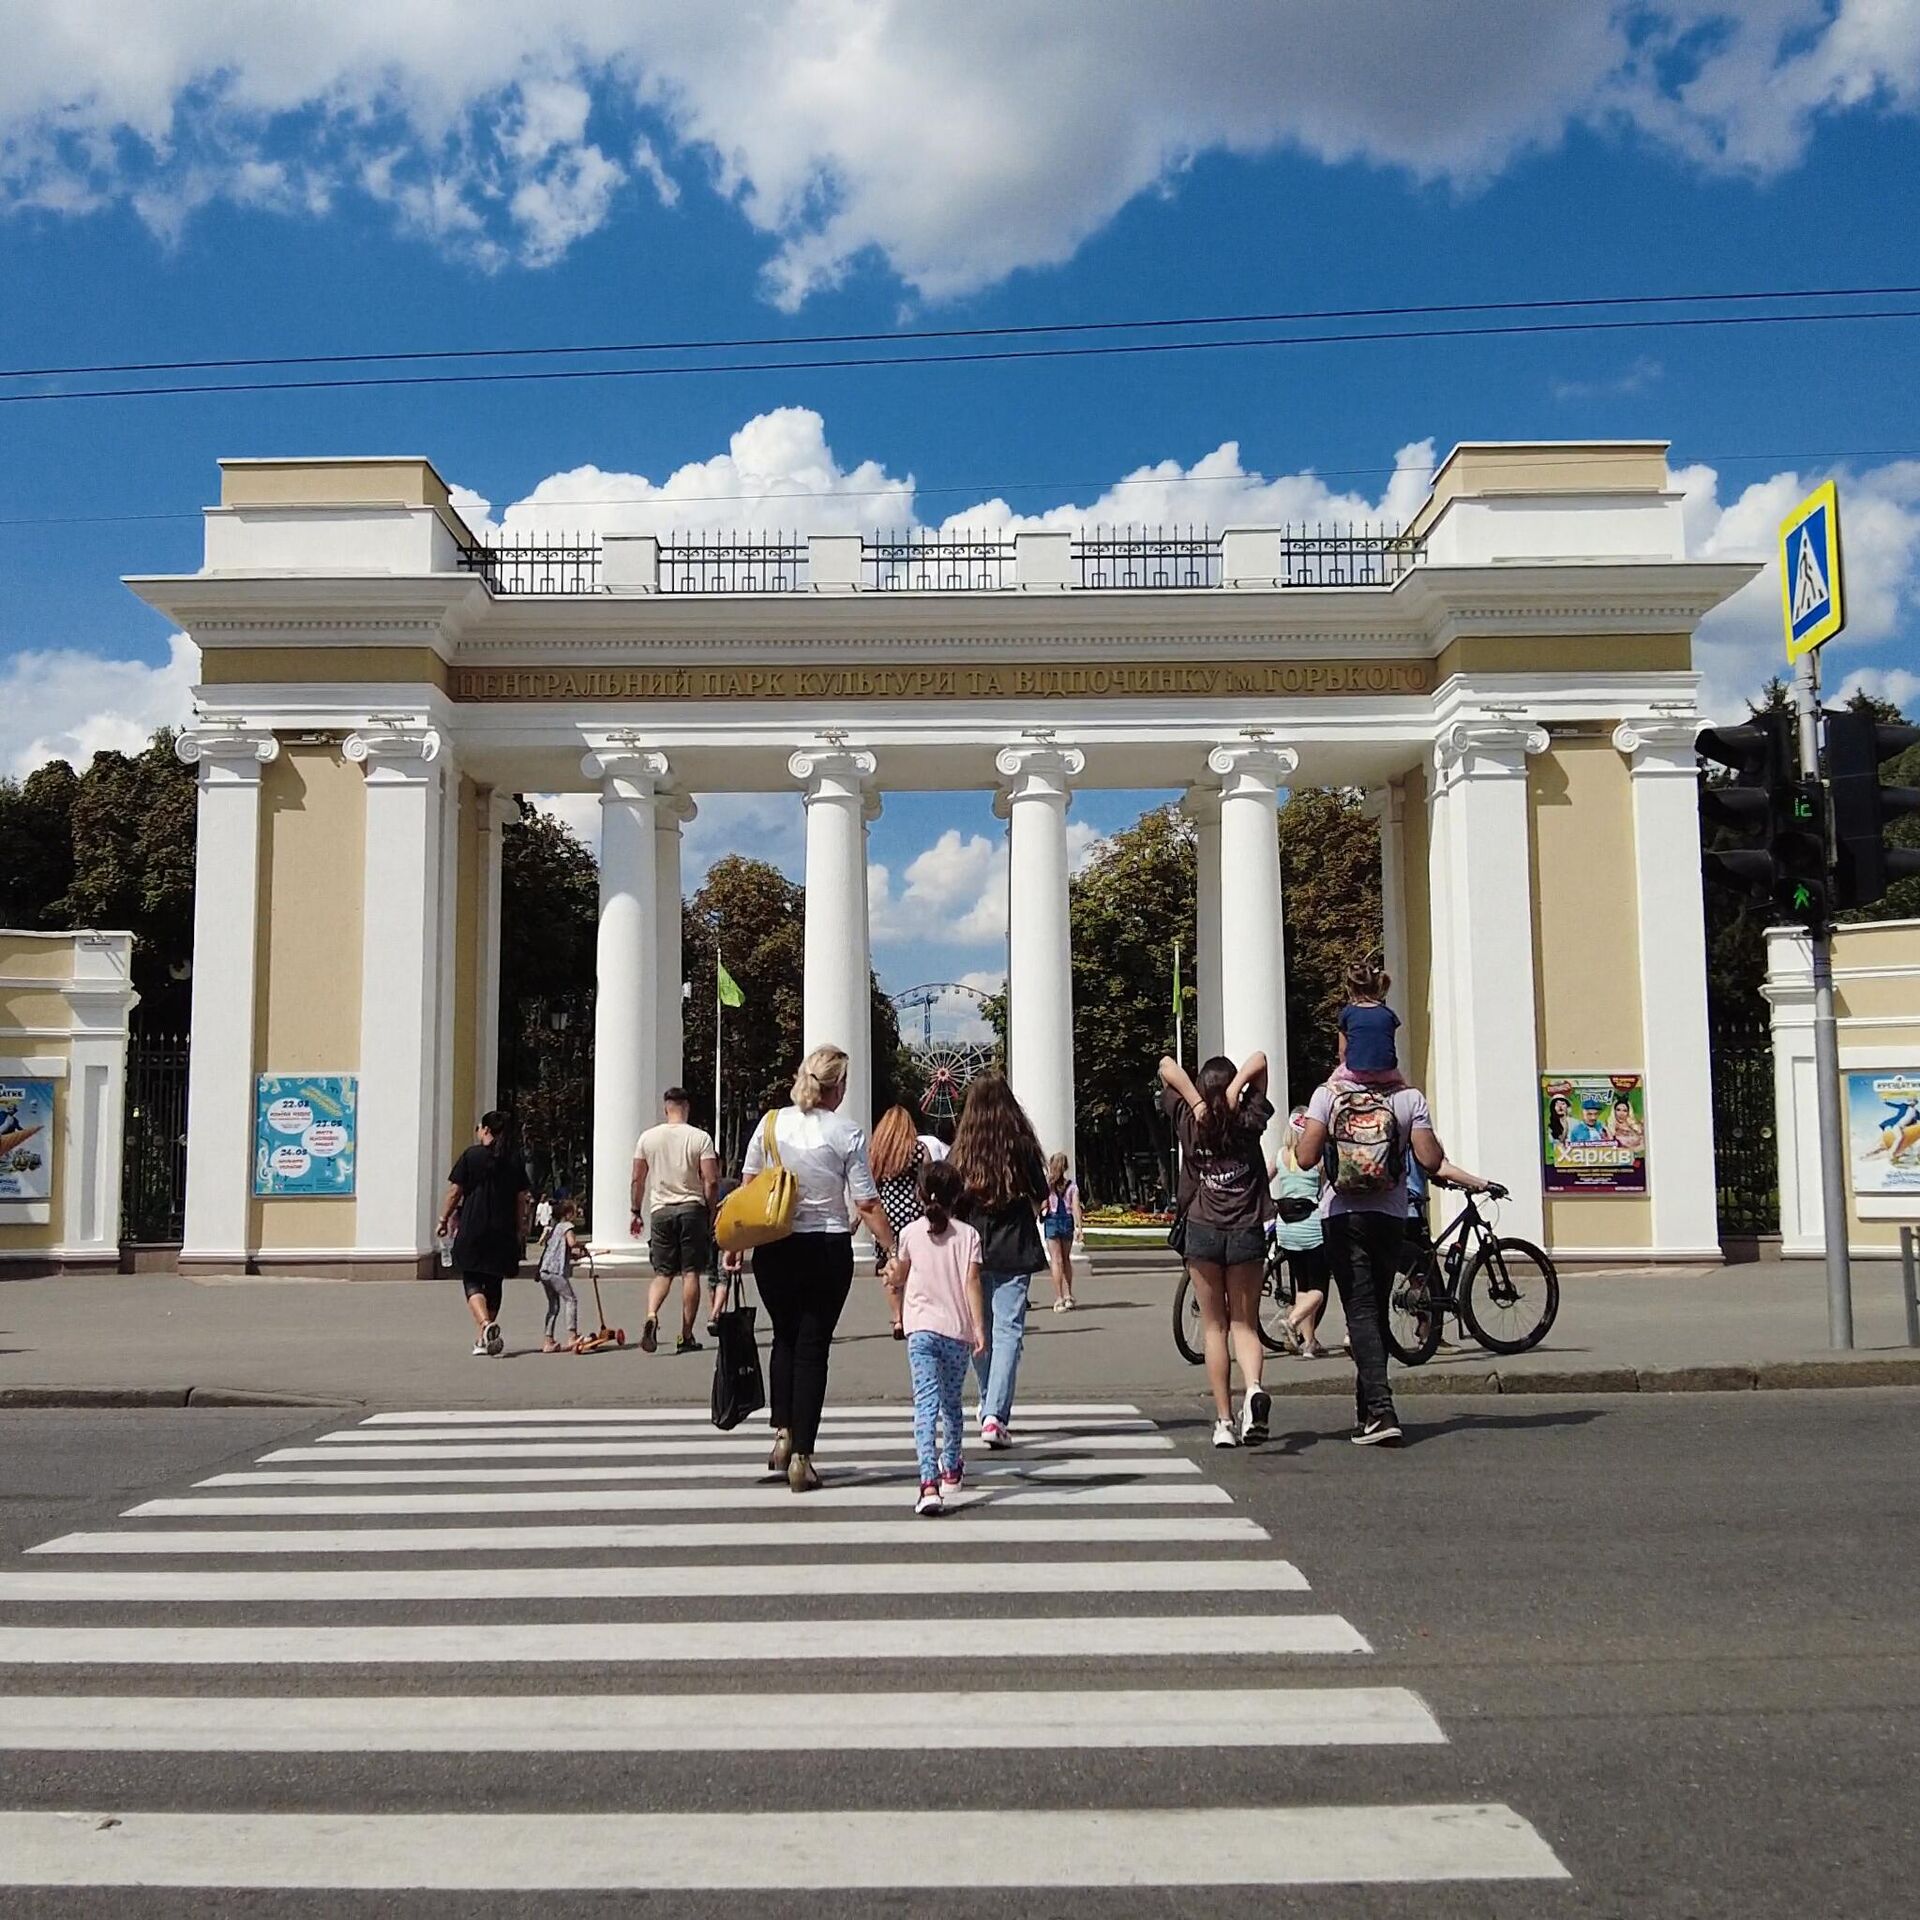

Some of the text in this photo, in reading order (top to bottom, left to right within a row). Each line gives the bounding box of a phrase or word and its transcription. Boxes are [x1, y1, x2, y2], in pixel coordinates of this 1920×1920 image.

[457, 669, 692, 699] ЦЕНТРАЛЬНИЙ
[702, 671, 785, 697] ПАРК
[794, 670, 956, 696] КУЛЬТУРИ
[967, 670, 1004, 695] ТА
[1014, 668, 1220, 698] ВІДПОЧИНКУ
[1263, 665, 1429, 692] ГОРЬКОГО
[1557, 1145, 1632, 1167] Харків
